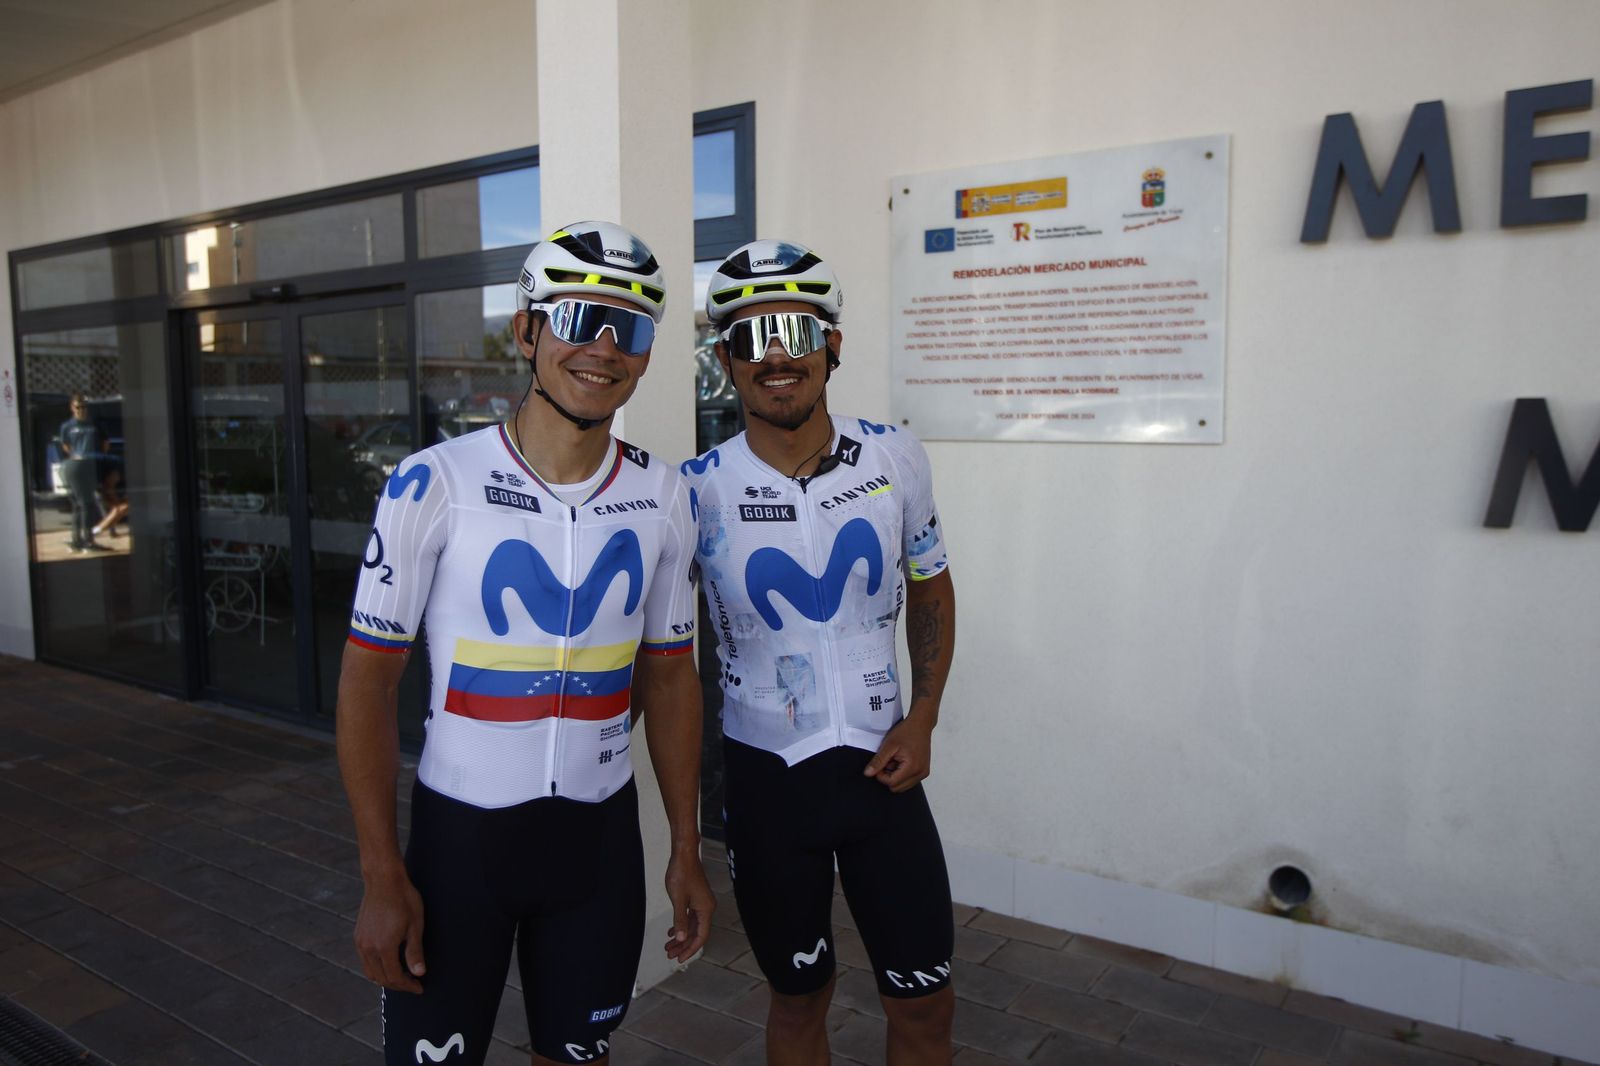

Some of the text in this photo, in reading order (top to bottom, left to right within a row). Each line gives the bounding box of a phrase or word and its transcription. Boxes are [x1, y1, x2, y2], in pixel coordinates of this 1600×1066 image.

[1300, 78, 1593, 243] ME
[953, 257, 1147, 280] REMODELACIÓN MERCADO MUNICIPAL
[489, 487, 535, 510] GOBIK
[820, 475, 890, 510] CANYON
[593, 498, 659, 516] CANYON
[744, 506, 790, 520] GOBIK
[710, 579, 739, 660] Telefónica
[590, 1003, 623, 1021] GOBIK
